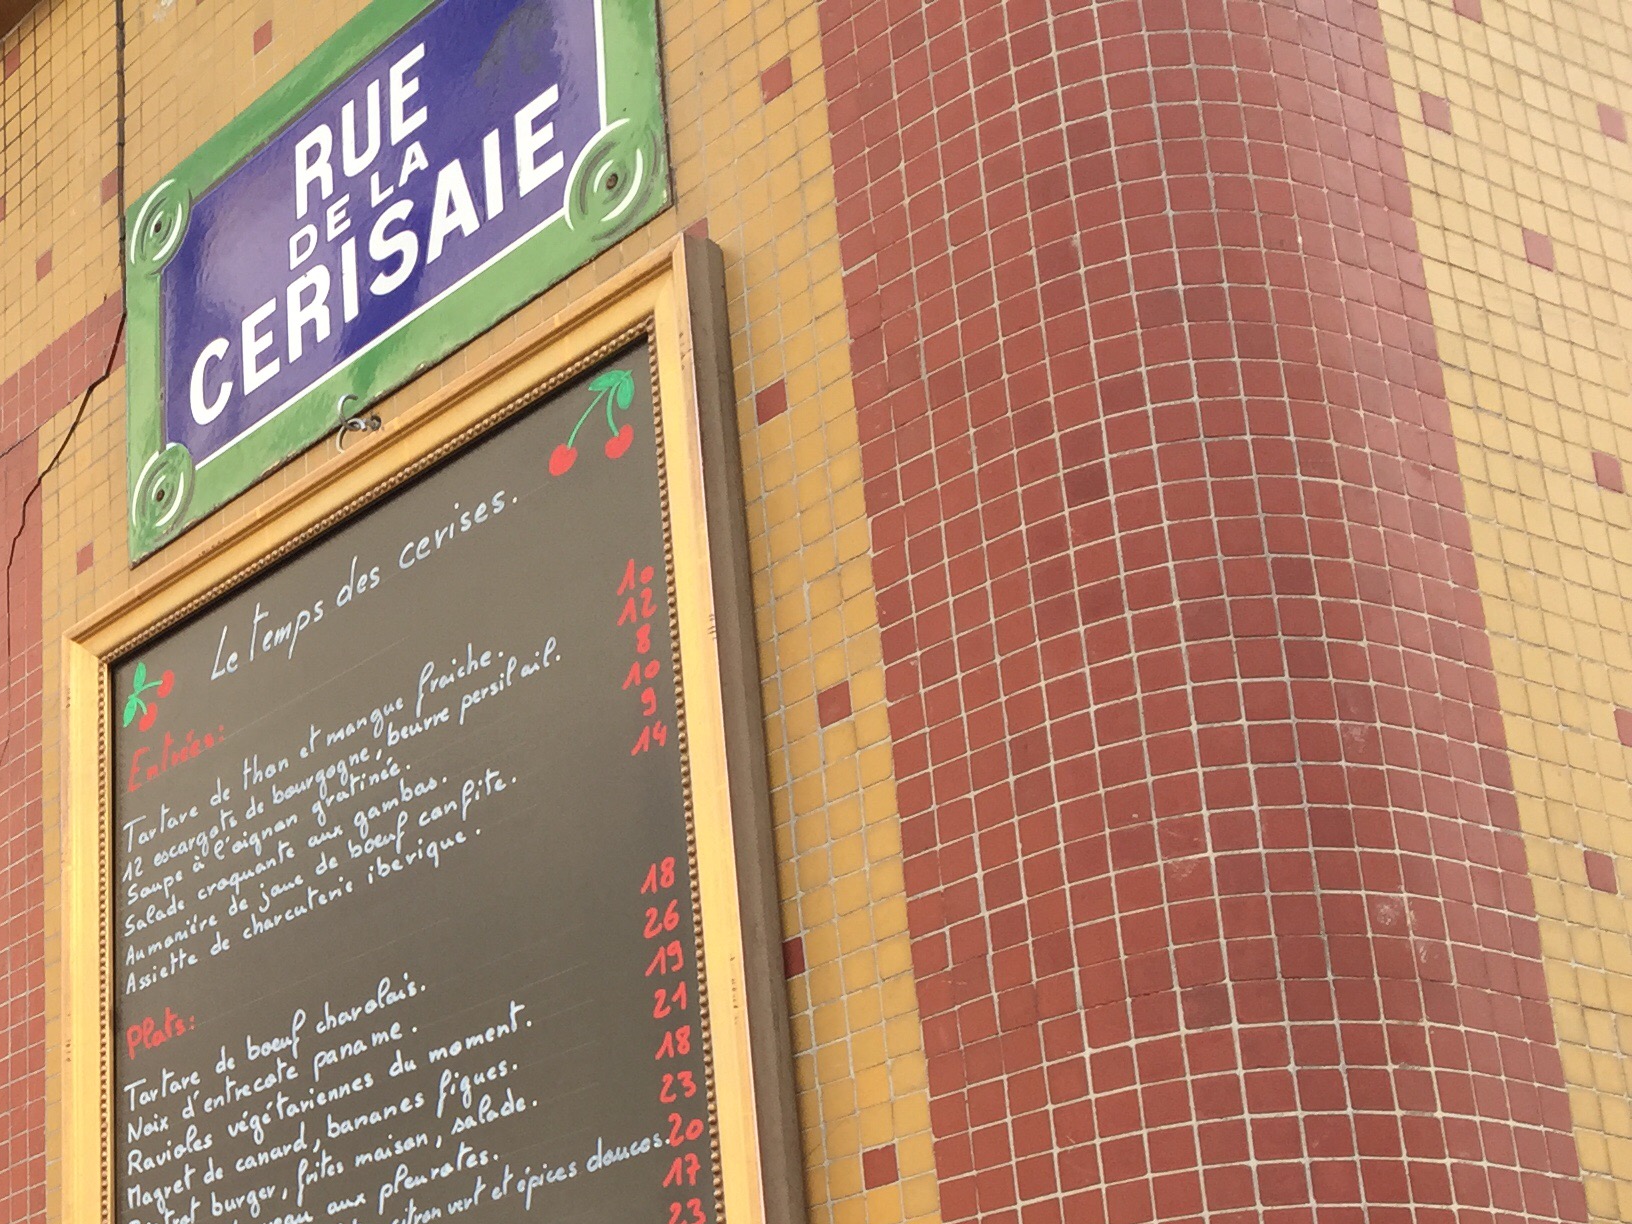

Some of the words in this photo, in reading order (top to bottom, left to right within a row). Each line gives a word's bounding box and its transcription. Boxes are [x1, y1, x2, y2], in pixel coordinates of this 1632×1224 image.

[295, 43, 428, 219] RUE
[289, 193, 350, 270] DE
[371, 142, 428, 208] LA
[189, 84, 564, 426] CERISAIE
[210, 625, 238, 681] Le
[249, 602, 324, 660] temps
[336, 555, 380, 607] des
[399, 489, 518, 570] cerises.
[617, 558, 654, 596] 10
[617, 587, 657, 627] 12
[636, 623, 651, 654] 8
[621, 659, 660, 690] 10
[640, 686, 656, 717] 9
[631, 720, 666, 756] 14
[122, 856, 143, 882] 12
[246, 795, 264, 820] de
[387, 707, 449, 746] beurre
[459, 656, 517, 725] persil
[123, 803, 198, 853] Tartare
[210, 777, 230, 805] de
[300, 724, 321, 758] et
[327, 697, 403, 746] mangue
[124, 893, 185, 937] Salade
[308, 824, 343, 848] aux
[127, 870, 183, 905] Soupe
[229, 894, 248, 916] de
[316, 851, 338, 875] de
[640, 856, 675, 895] 18
[643, 899, 680, 940] 26
[126, 948, 198, 995] Assiette
[210, 931, 230, 956] de
[645, 940, 684, 977] 19
[652, 981, 687, 1019] 21
[655, 1024, 692, 1061] 18
[124, 1067, 200, 1111] Tartare
[215, 1045, 235, 1074] de
[659, 1071, 697, 1104] 23
[127, 1124, 212, 1176] Ravioles
[388, 1049, 416, 1078] du
[127, 1113, 169, 1144] Noix
[668, 1112, 703, 1147] 20
[127, 1163, 195, 1214] Magret
[203, 1157, 223, 1184] de
[327, 1092, 424, 1138] bananes
[662, 1153, 701, 1188] 17
[297, 1149, 344, 1207] frites
[448, 1175, 486, 1215] vert
[491, 1163, 514, 1200] et
[327, 1192, 366, 1215] aux
